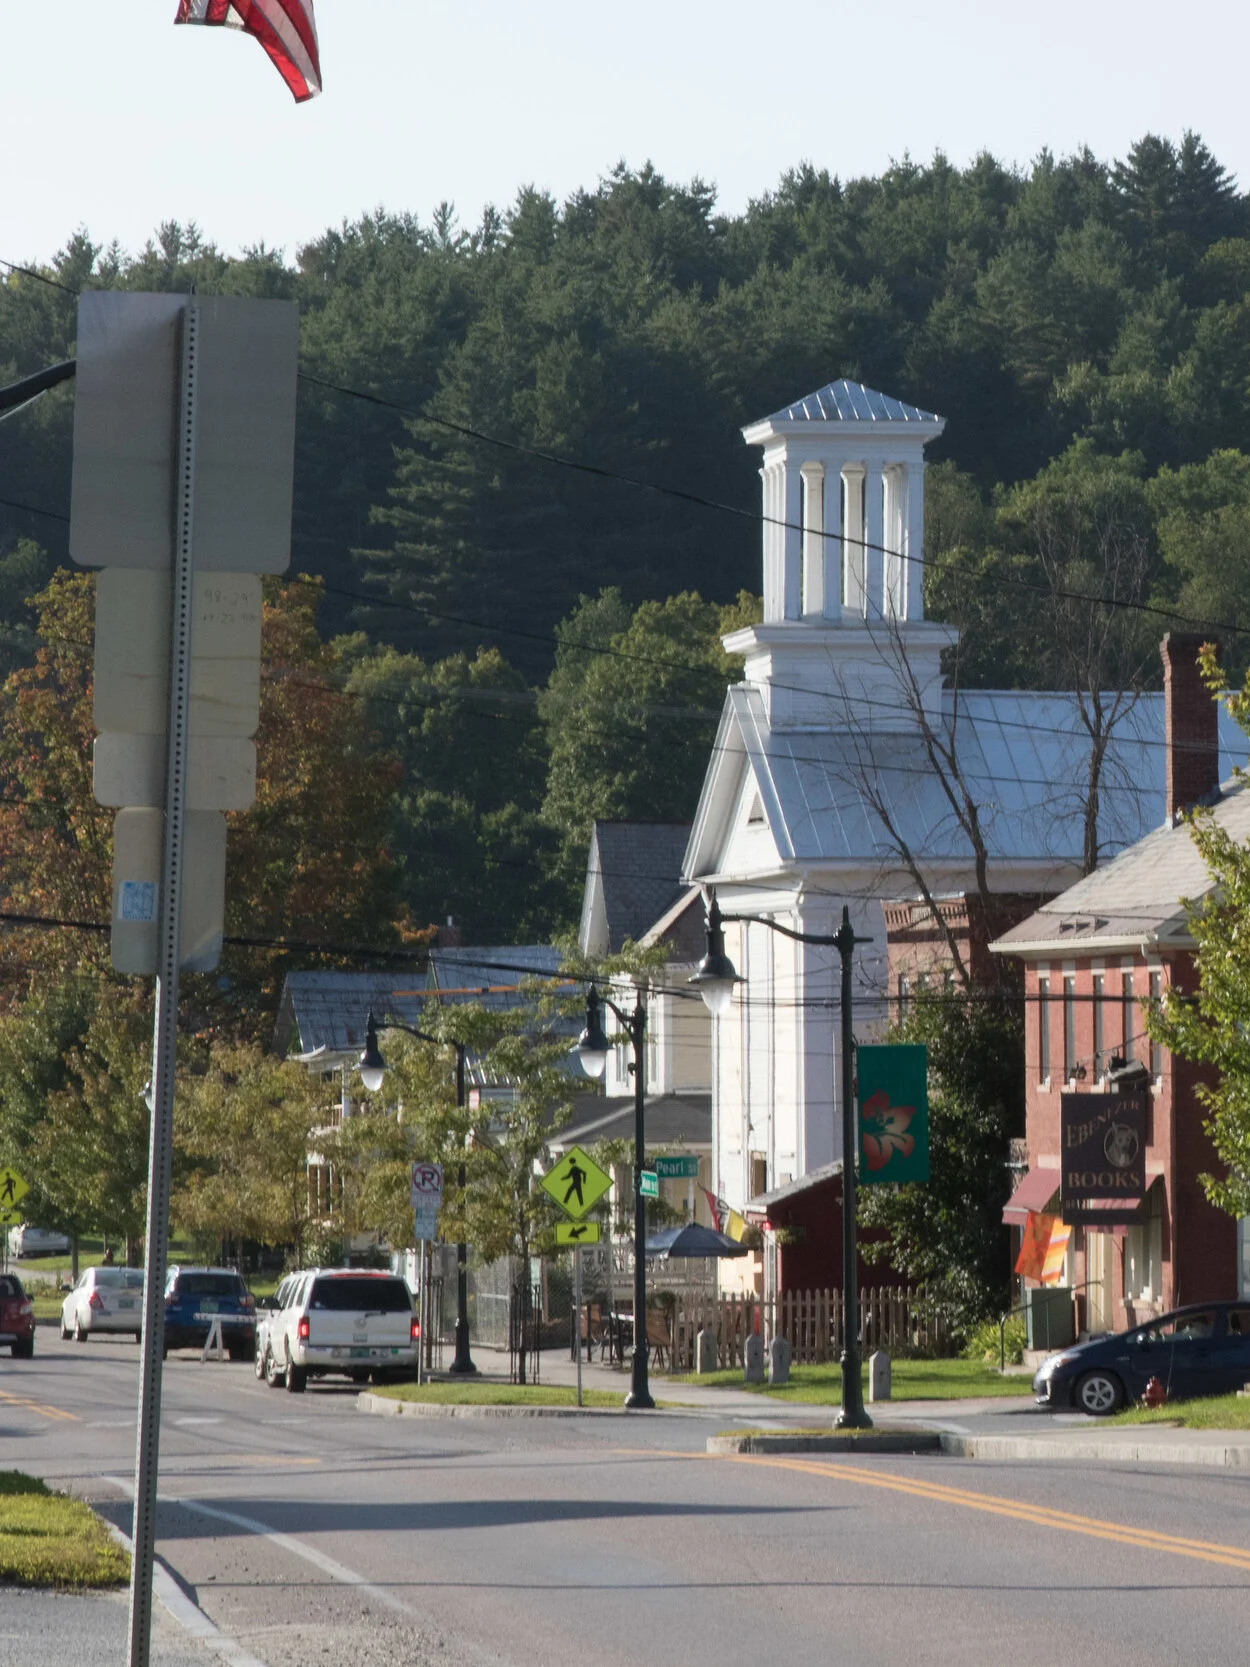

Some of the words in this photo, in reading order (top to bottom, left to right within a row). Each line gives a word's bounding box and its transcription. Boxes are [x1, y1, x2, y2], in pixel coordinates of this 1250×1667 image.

[1066, 1099, 1140, 1148] EBENEZER
[656, 1160, 684, 1175] Pearl
[1068, 1171, 1140, 1189] BOOKS
